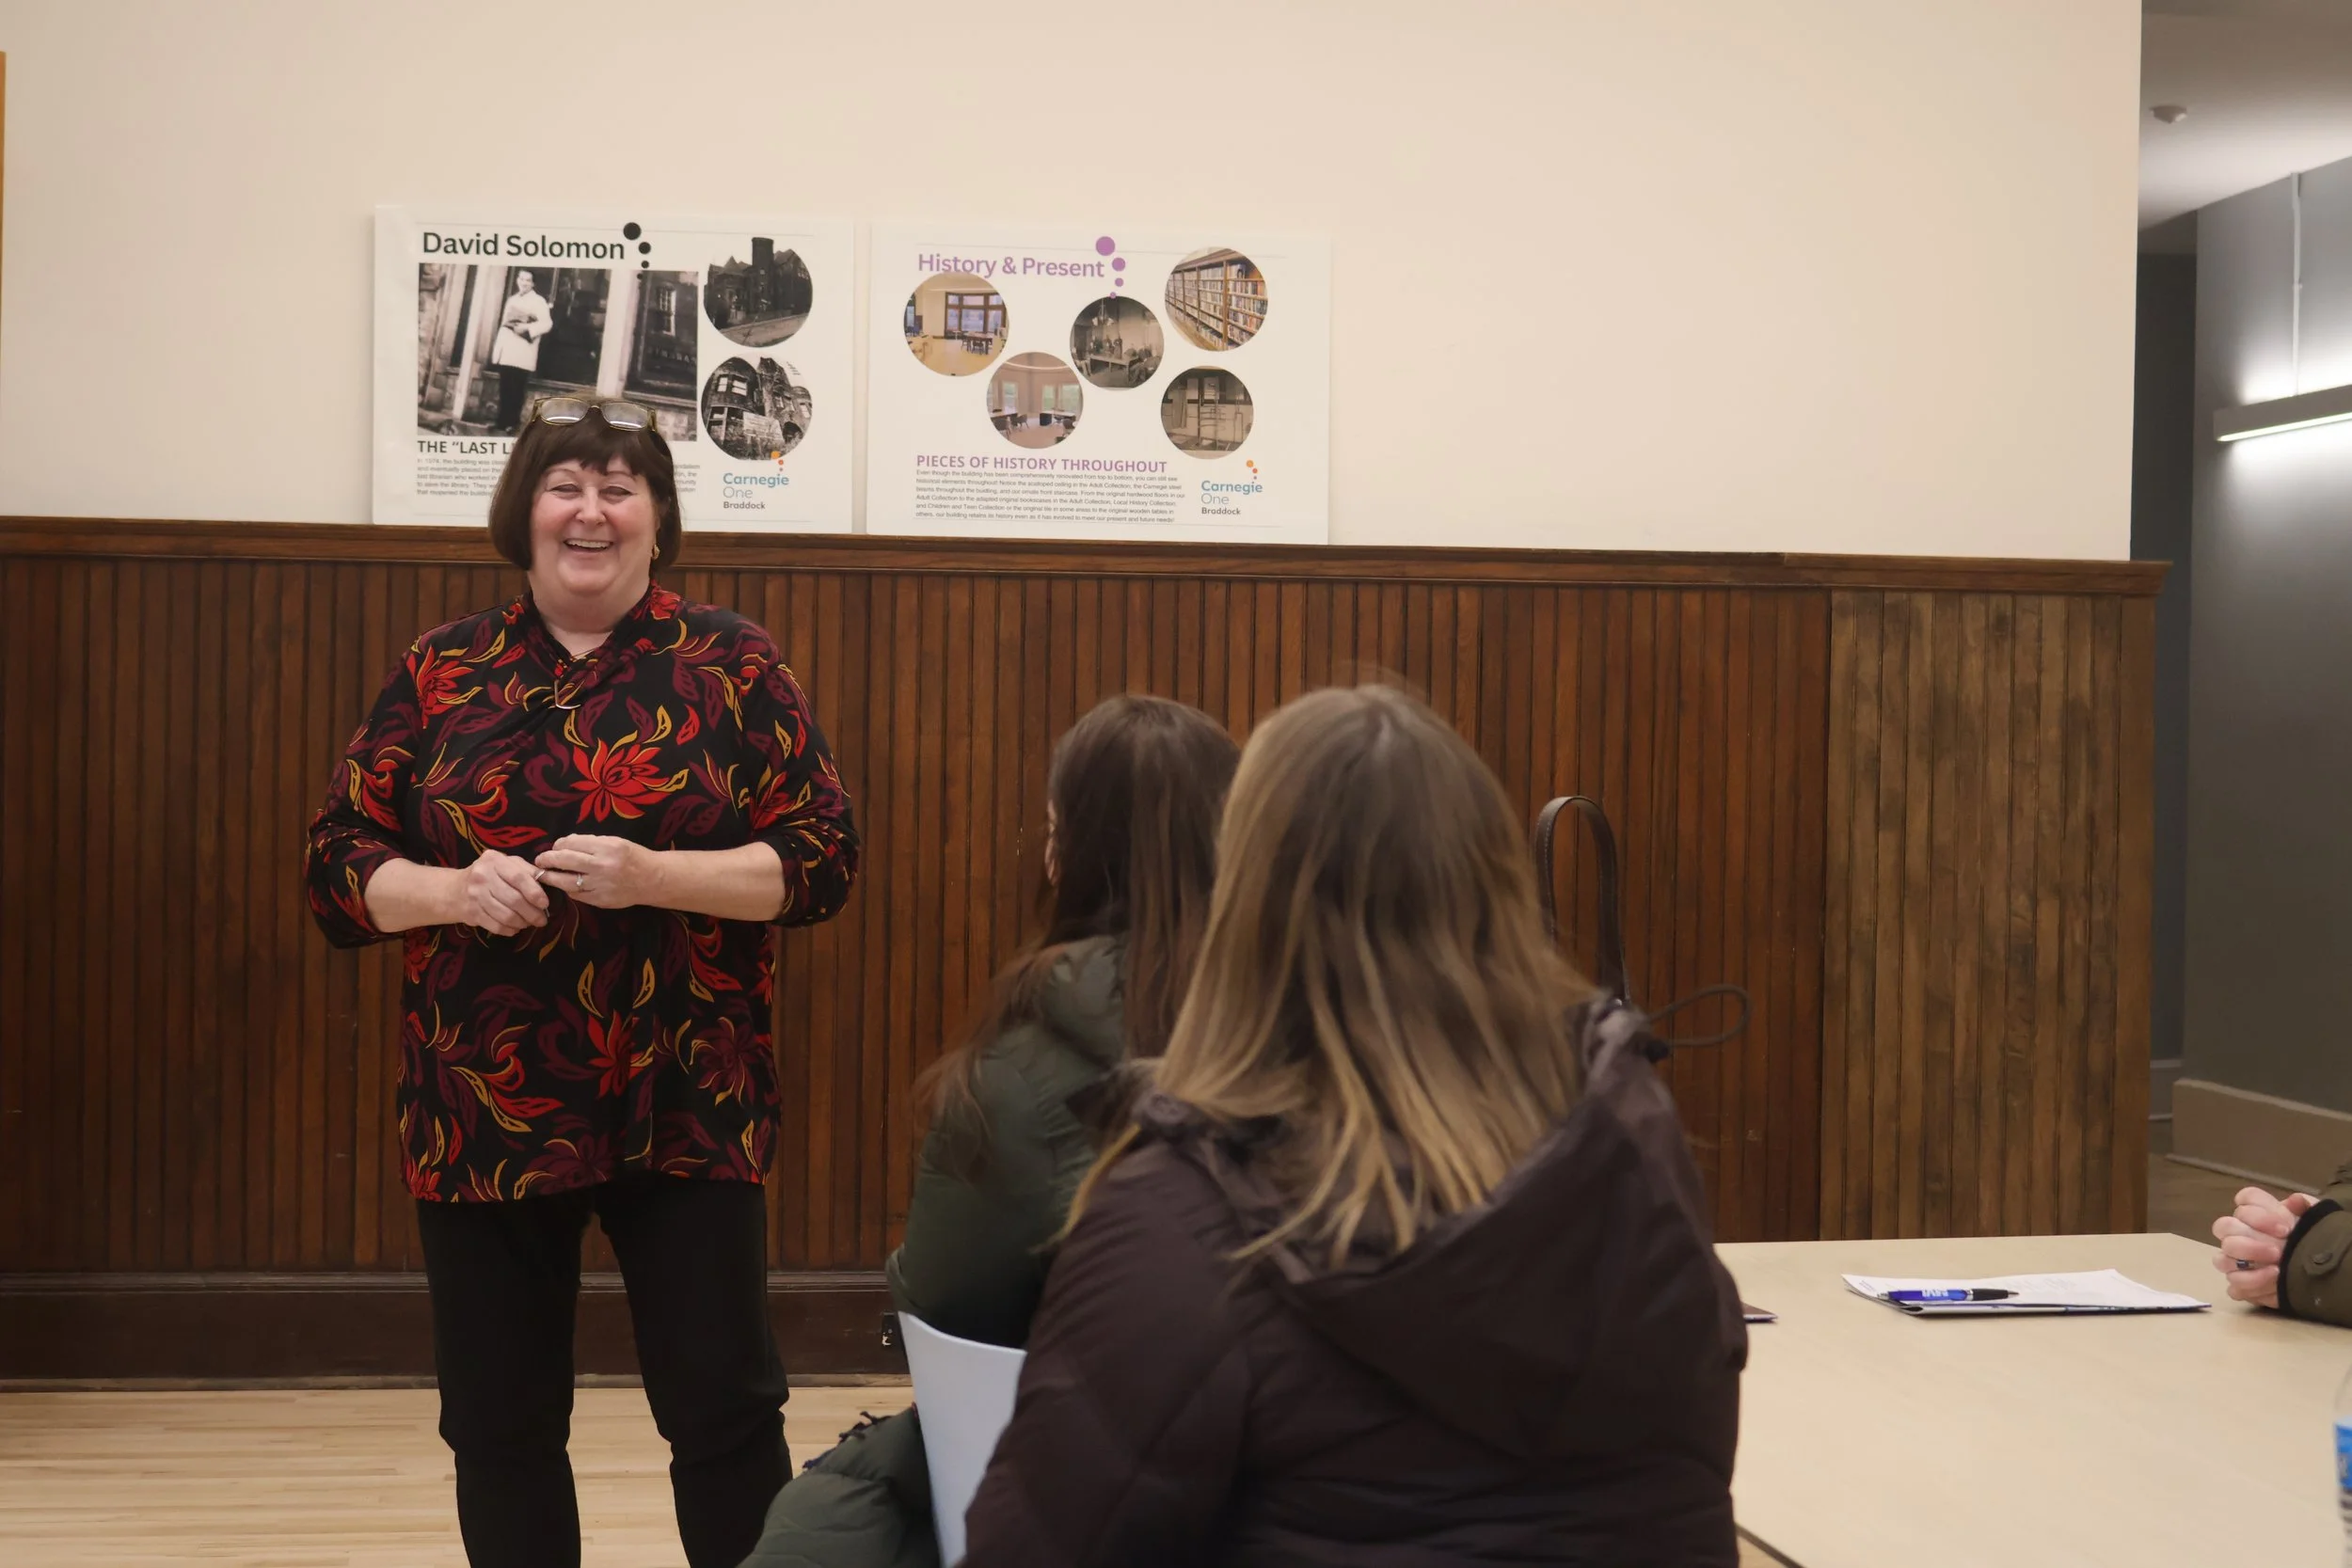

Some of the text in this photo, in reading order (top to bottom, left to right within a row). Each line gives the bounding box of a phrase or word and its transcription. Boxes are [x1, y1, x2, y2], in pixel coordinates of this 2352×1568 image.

[422, 231, 625, 260] David Solomon
[917, 253, 1105, 279] History & Present
[417, 440, 448, 453] THE
[452, 441, 498, 454] “LAST
[916, 455, 1167, 472] PIECES OF HISTORY THROUGHOUT
[723, 472, 789, 487] Carnegie
[723, 488, 753, 499] One
[1200, 481, 1263, 495] Carnegie
[723, 501, 766, 510] Braddock
[1200, 493, 1230, 505] One
[1201, 507, 1241, 515] Braddock
